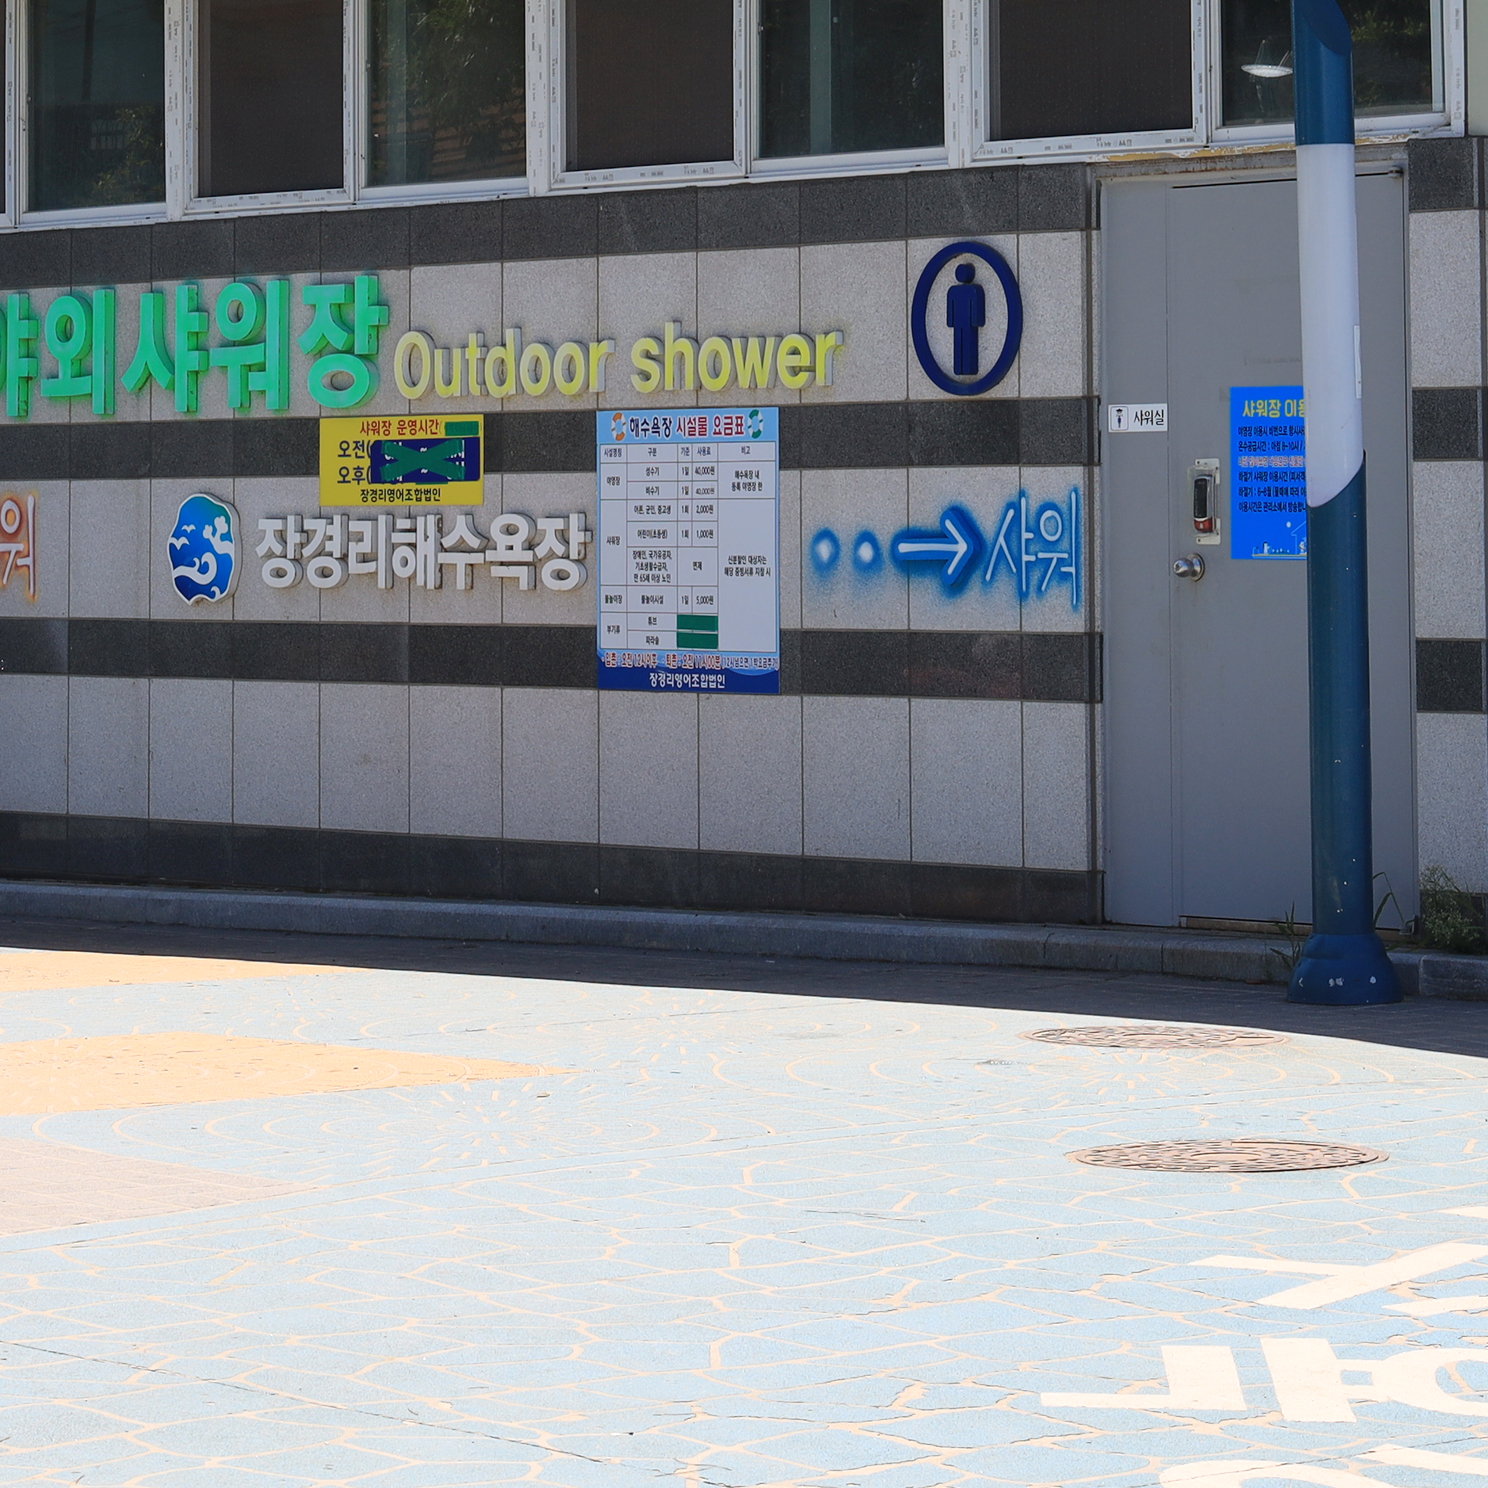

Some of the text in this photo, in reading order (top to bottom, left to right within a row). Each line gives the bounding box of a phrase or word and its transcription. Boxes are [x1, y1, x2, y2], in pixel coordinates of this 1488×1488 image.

[393, 320, 844, 400] Outdoor shower
[1242, 399, 1282, 418] 샤워장
[629, 415, 745, 438] 해수욕장 시설물 요금표
[1133, 409, 1165, 427] 샤워실
[360, 419, 392, 437] 샤워장
[697, 446, 711, 457] 사용료
[740, 445, 751, 455] 비고
[606, 476, 620, 486] 야영장
[734, 470, 753, 480] 해수욕장
[360, 487, 441, 502] 장경리영어조합법인
[696, 504, 713, 514] 2,000원
[696, 529, 713, 539] 1,000원
[255, 511, 593, 592] 장경리해수욕장
[985, 486, 1080, 611] 샤워
[696, 595, 714, 605] 5,000원
[649, 672, 726, 689] 장경리영어조합법인
